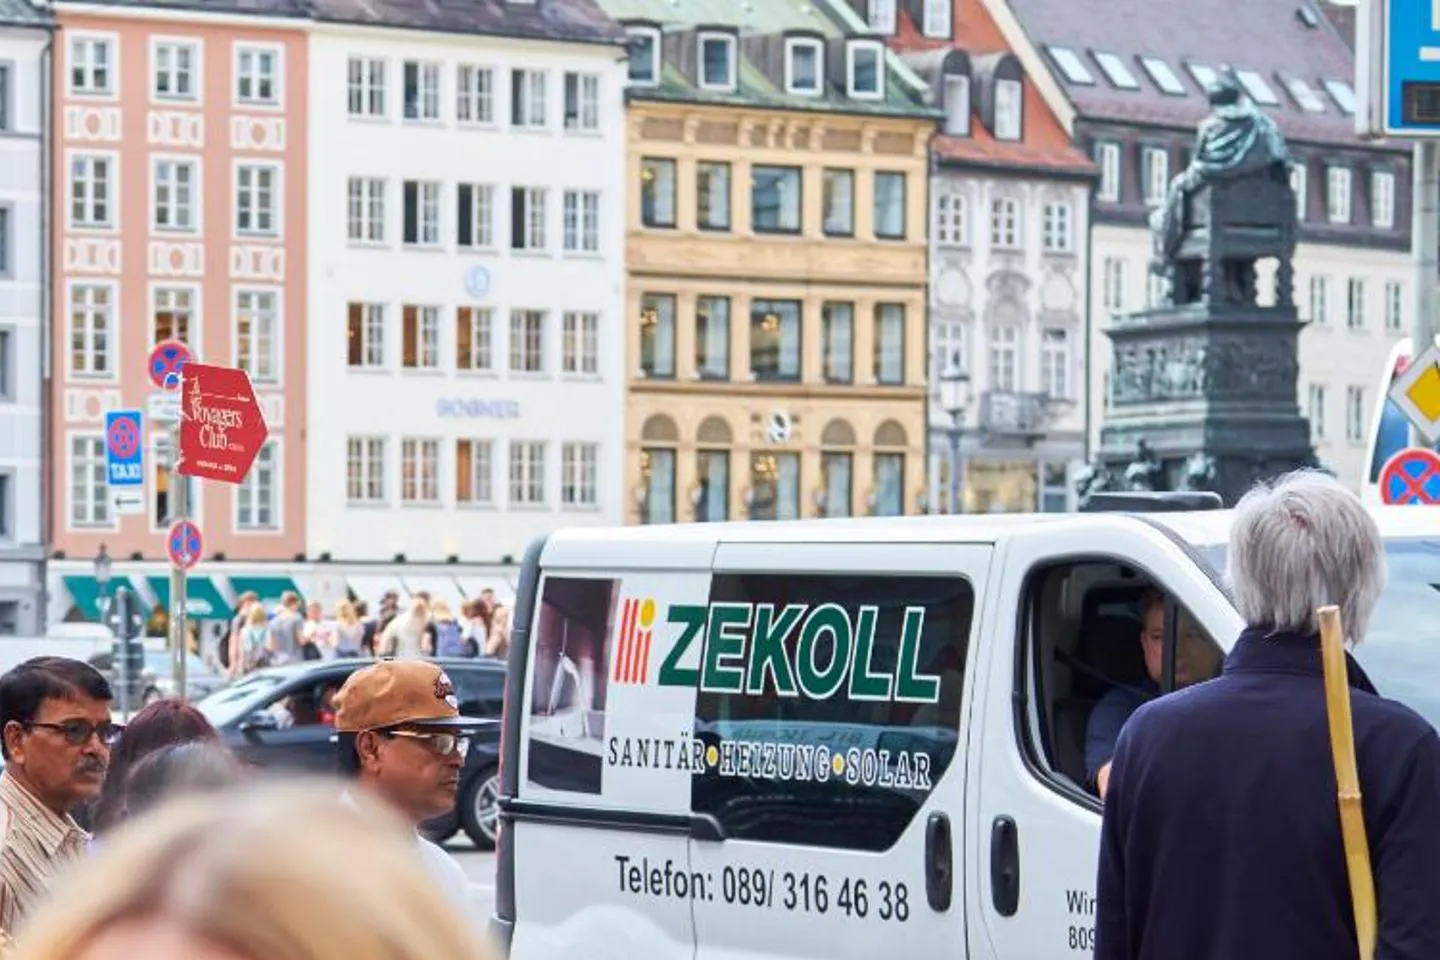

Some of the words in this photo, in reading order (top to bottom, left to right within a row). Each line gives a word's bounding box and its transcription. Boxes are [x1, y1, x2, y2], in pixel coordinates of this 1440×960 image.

[191, 402, 243, 430] Voyagers
[199, 425, 228, 450] Club
[110, 463, 142, 480] TAXI
[658, 602, 942, 703] ZEKOLL
[608, 732, 706, 774] SANITÄR
[719, 739, 831, 783] HEIZUNG
[845, 746, 932, 791] SOLAR
[615, 855, 713, 900] Telefon:
[722, 866, 774, 907] 089/
[783, 872, 829, 914] 316
[837, 877, 869, 918] 46
[878, 881, 910, 922] 38
